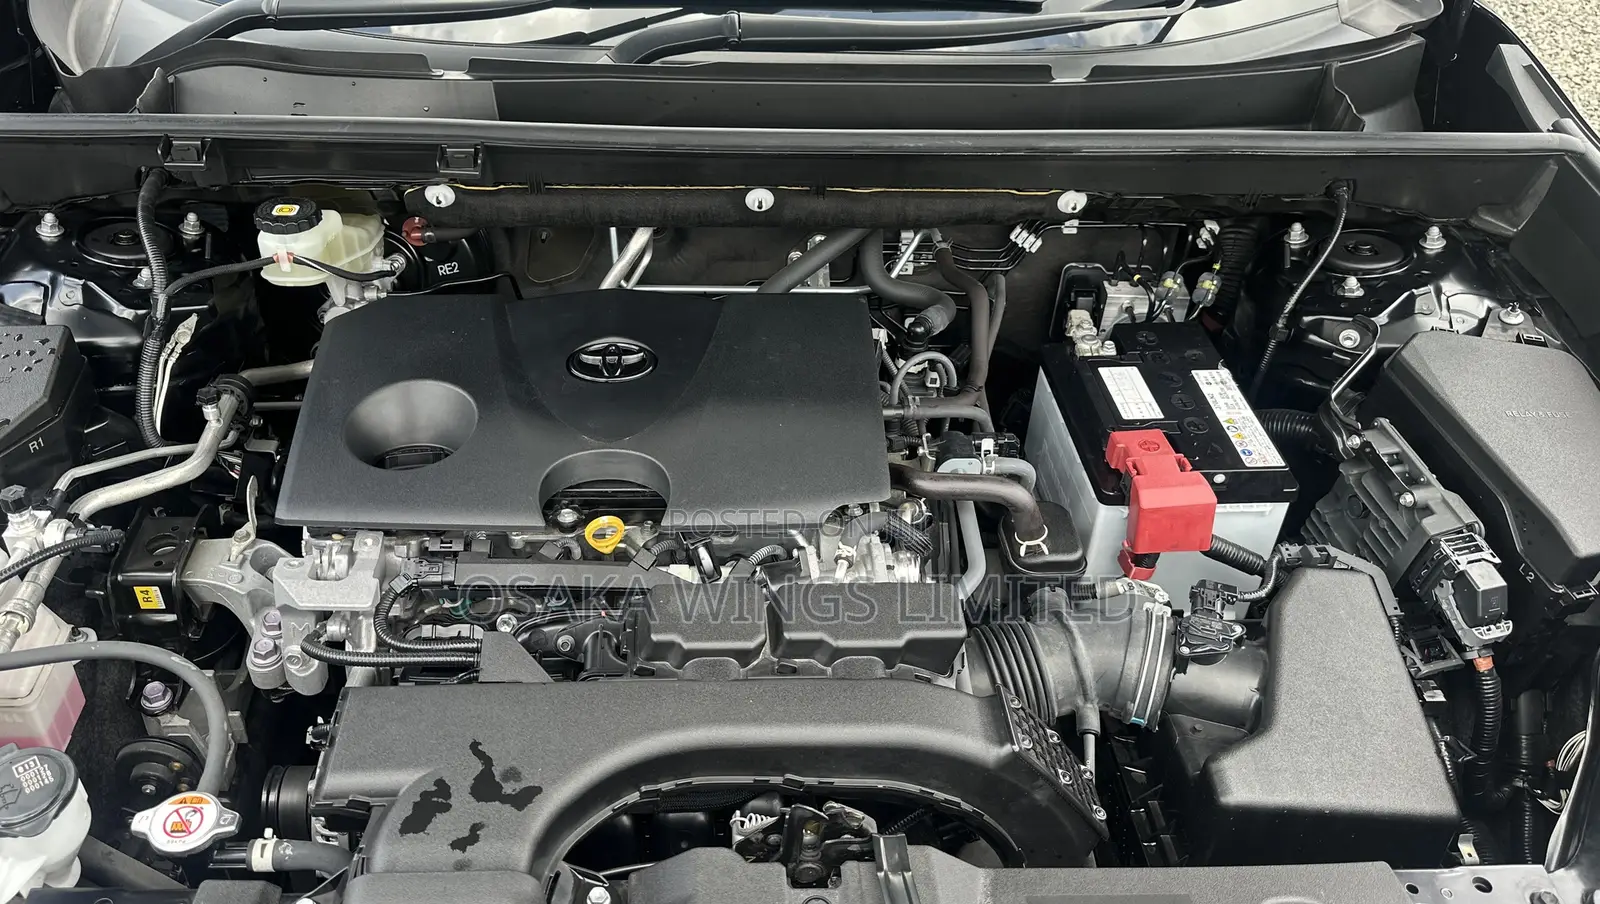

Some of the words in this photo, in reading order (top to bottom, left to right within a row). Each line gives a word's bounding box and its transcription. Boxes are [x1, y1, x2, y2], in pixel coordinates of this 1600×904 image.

[437, 261, 460, 276] RE2
[1504, 410, 1538, 419] RELAY
[28, 436, 45, 453] R1
[1518, 562, 1536, 584] L2
[140, 589, 153, 604] R4
